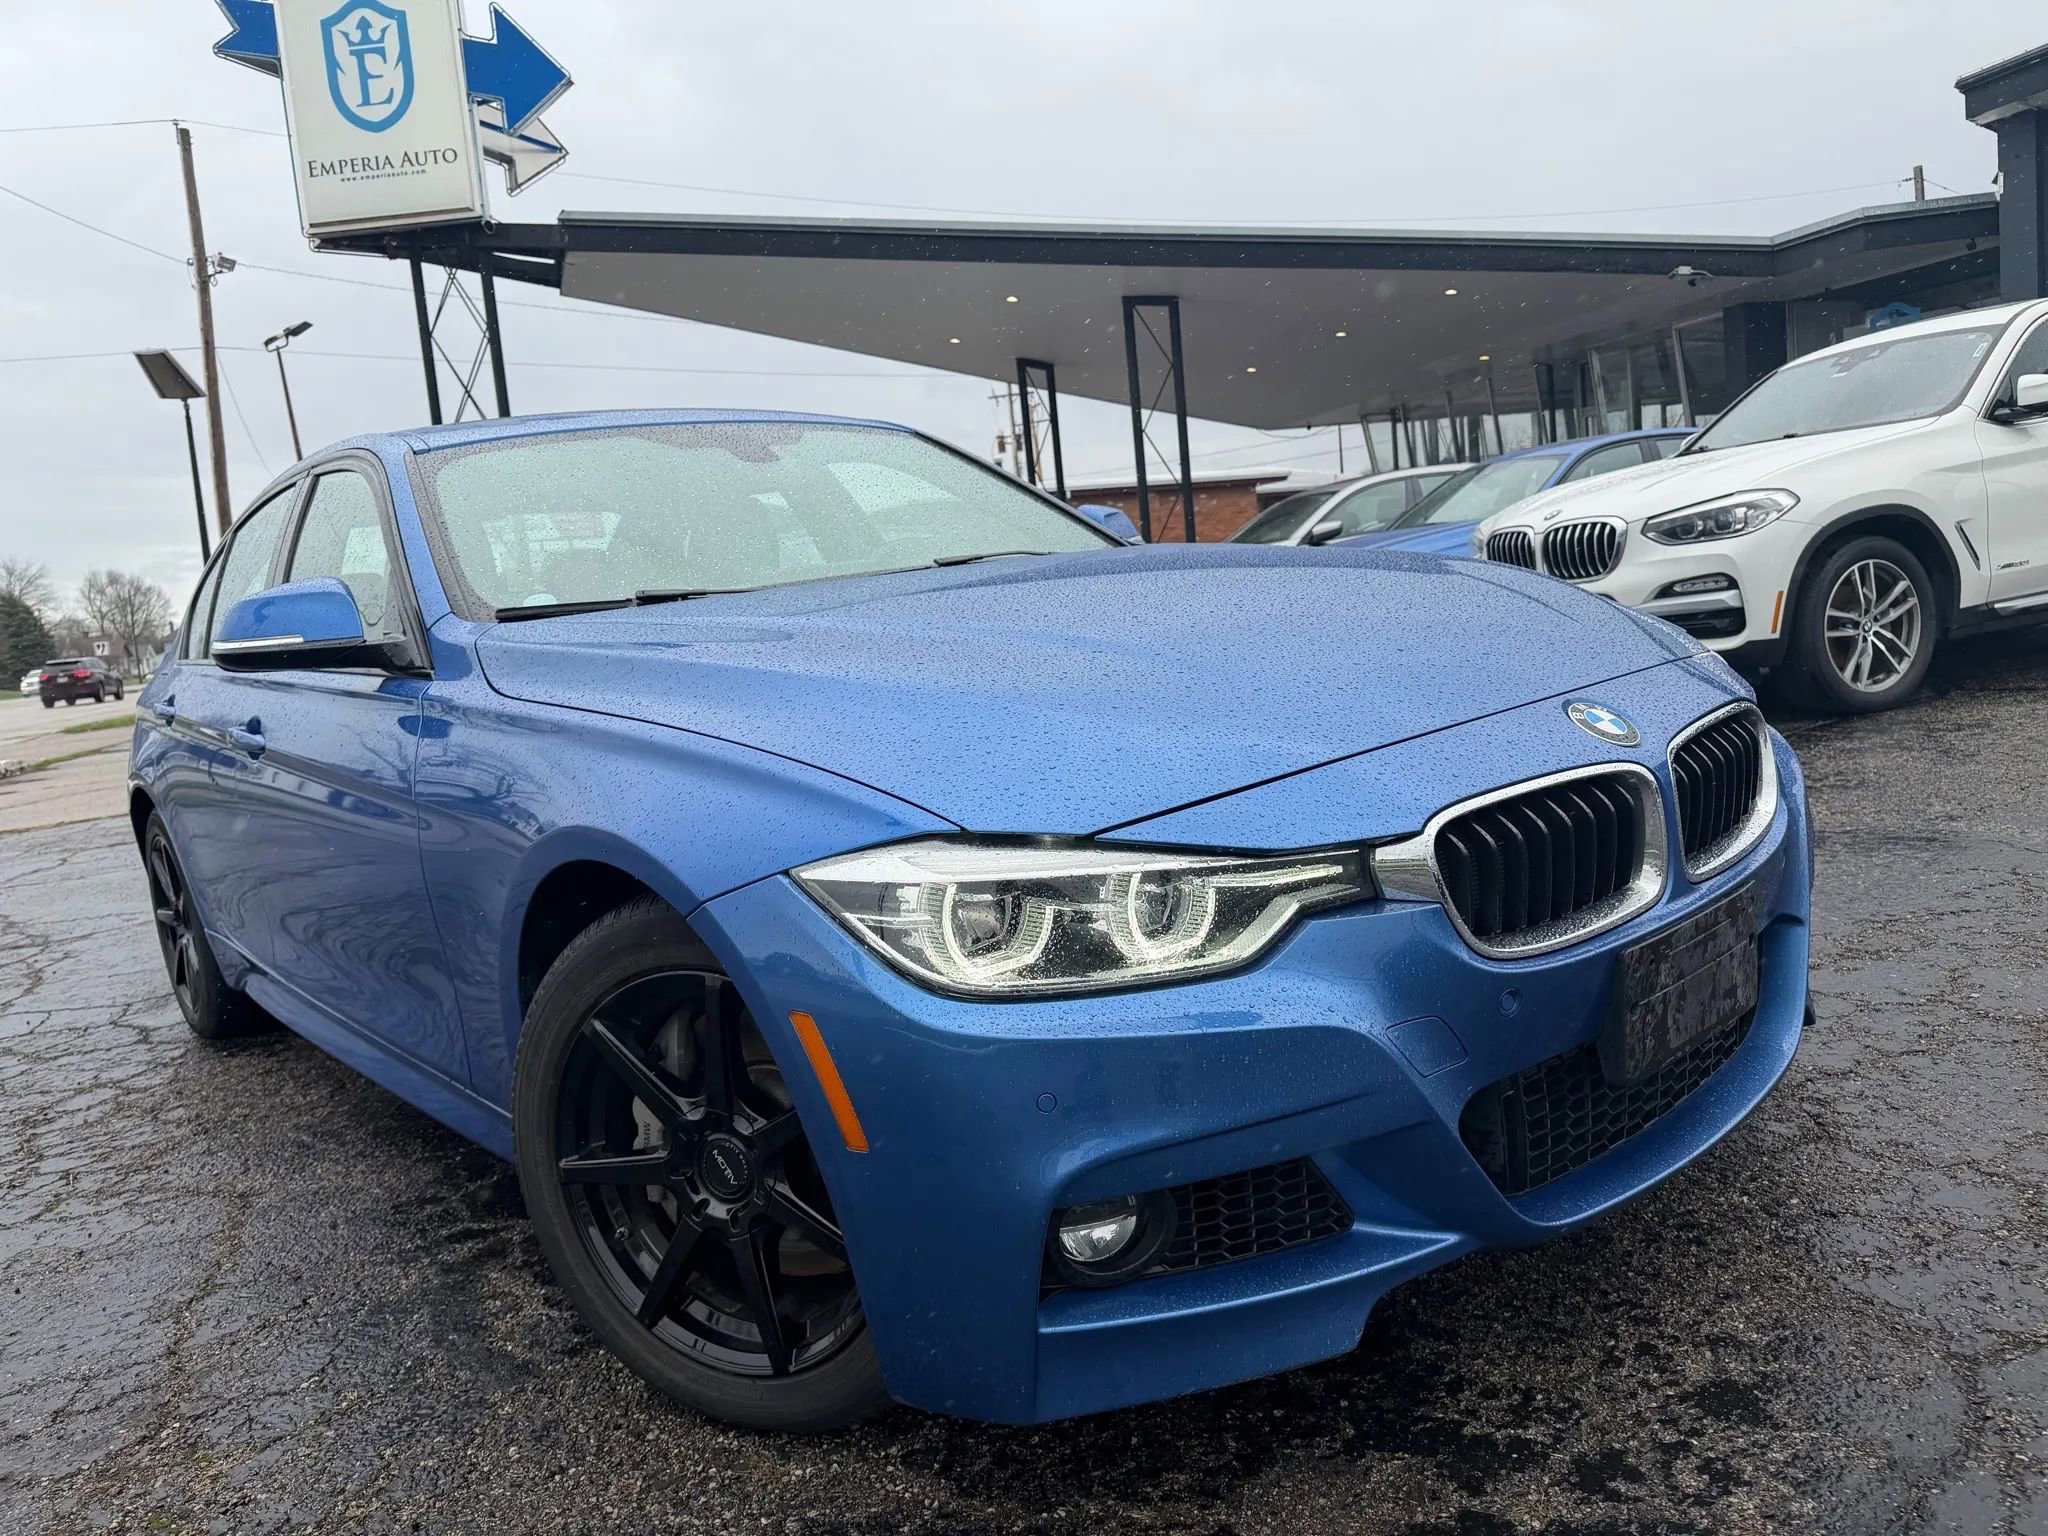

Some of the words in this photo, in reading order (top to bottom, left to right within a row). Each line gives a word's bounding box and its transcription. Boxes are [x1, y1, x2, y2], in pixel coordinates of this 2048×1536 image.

[349, 46, 394, 107] E
[308, 154, 395, 178] EMPERIA
[401, 148, 458, 168] AUTO
[340, 168, 427, 182] www.emperiaauto.com
[712, 1149, 738, 1185] MOTIV
